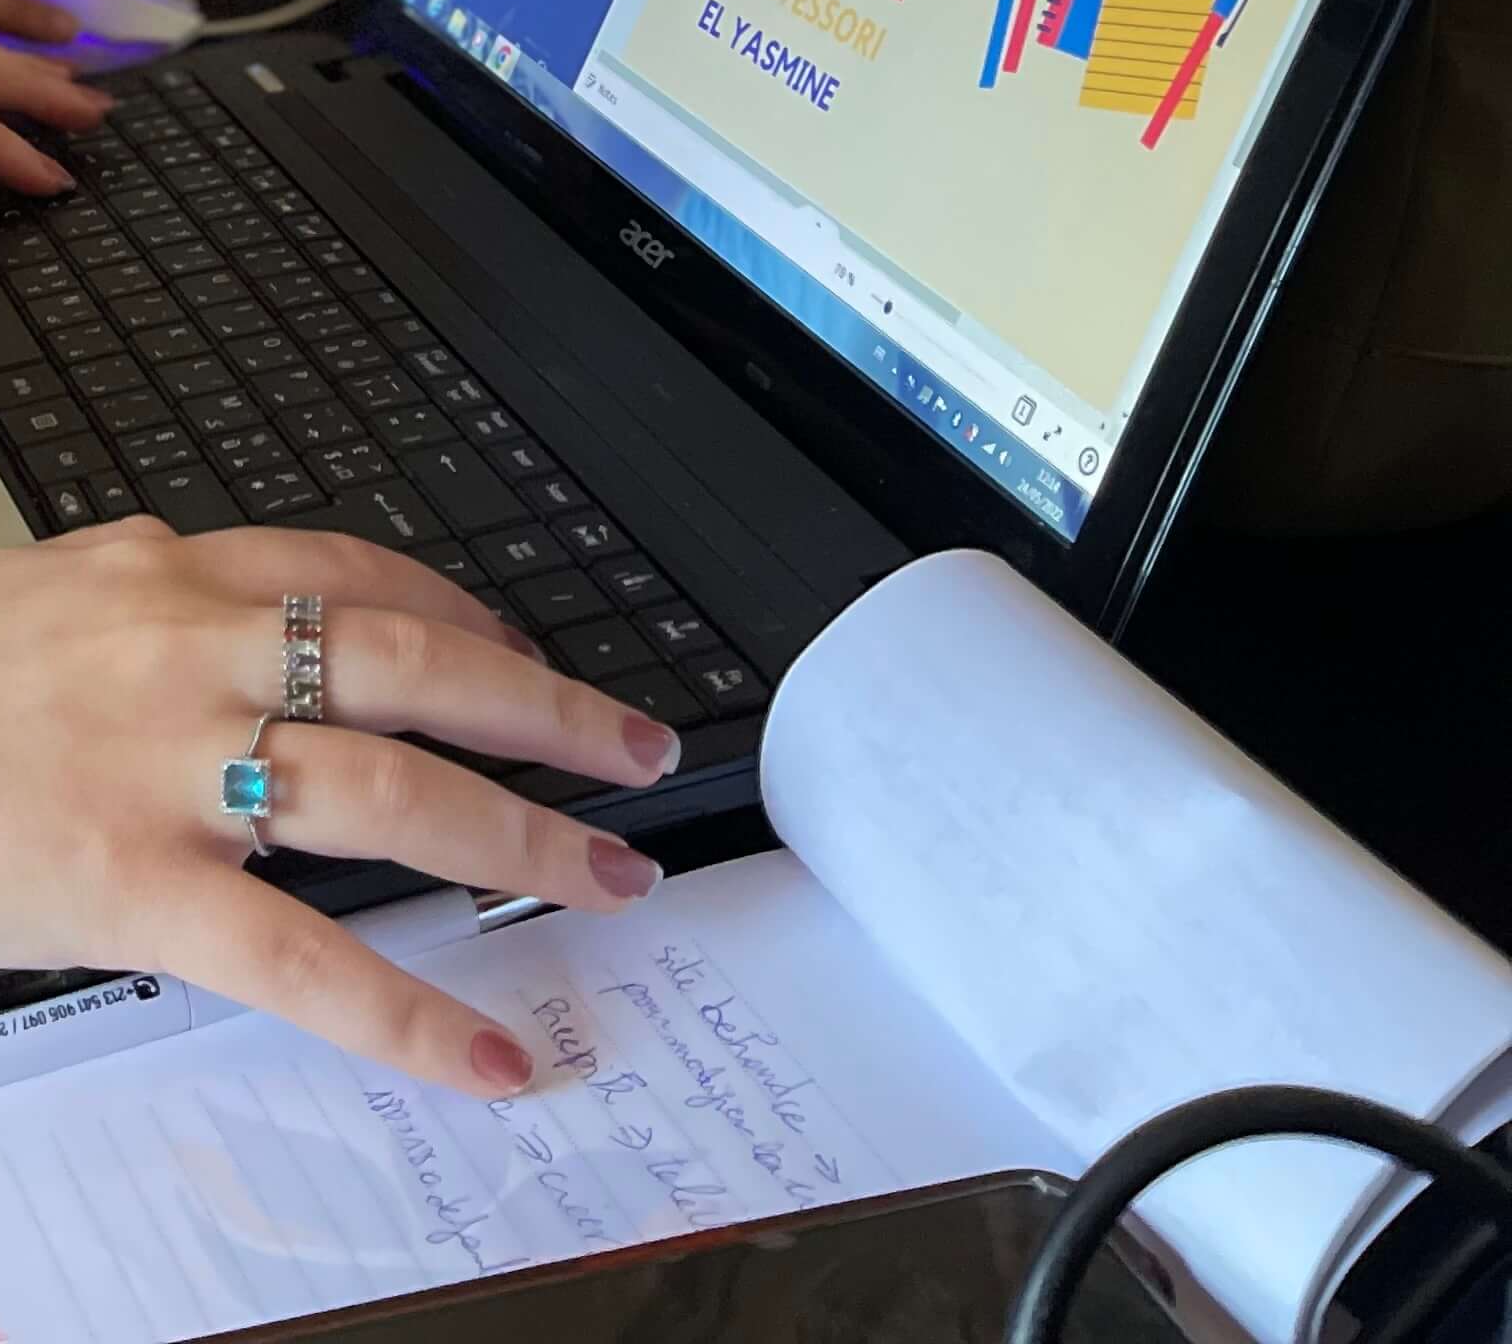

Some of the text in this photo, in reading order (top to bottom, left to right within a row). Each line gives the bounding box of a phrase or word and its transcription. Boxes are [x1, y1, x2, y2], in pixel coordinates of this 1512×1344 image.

[698, 0, 840, 111] EL YASMINE
[596, 83, 618, 106] Notes
[618, 219, 675, 271] acer
[77, 994, 102, 1015] 541
[102, 986, 135, 1007] +213
[22, 1009, 47, 1030] 097
